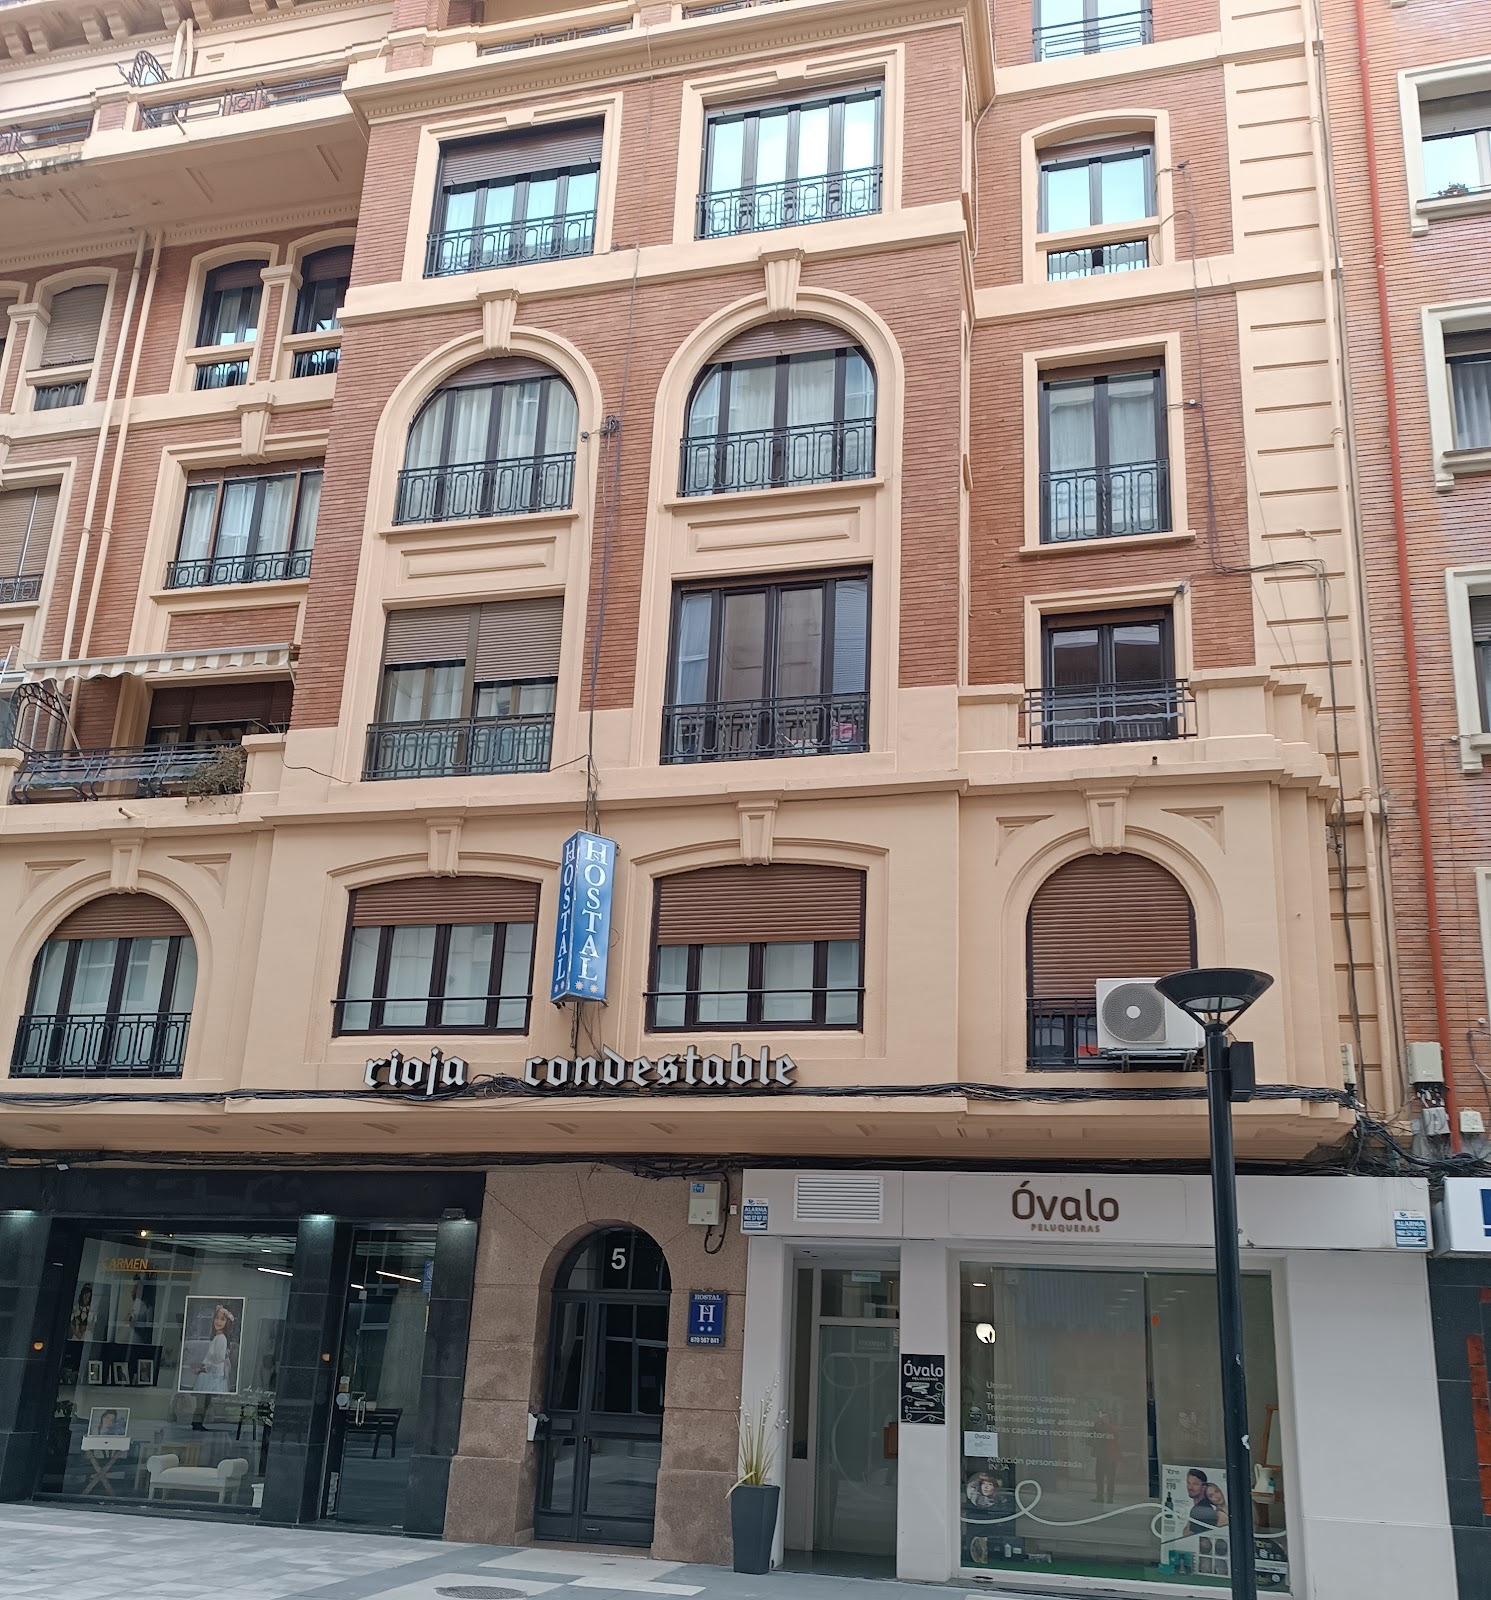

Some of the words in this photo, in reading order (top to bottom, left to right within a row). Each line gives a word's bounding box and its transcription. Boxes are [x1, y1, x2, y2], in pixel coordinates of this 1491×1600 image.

[555, 838, 576, 981] HOSTAL
[577, 838, 609, 981] HOSTAL
[363, 1046, 468, 1096] rioja
[524, 1043, 797, 1087] condestable
[1012, 1180, 1119, 1222] Óvalo
[1030, 1224, 1100, 1233] PELUQUERAS
[611, 1247, 626, 1270] 5
[694, 1293, 721, 1301] HOSTAL
[903, 1359, 944, 1377] Óvalo
[986, 1381, 1012, 1390] Unisex
[986, 1391, 1038, 1402] Tratamientos
[986, 1403, 1035, 1413] Tratamiento
[986, 1413, 1035, 1424] Tratamiento
[1011, 1427, 1048, 1436] capilares
